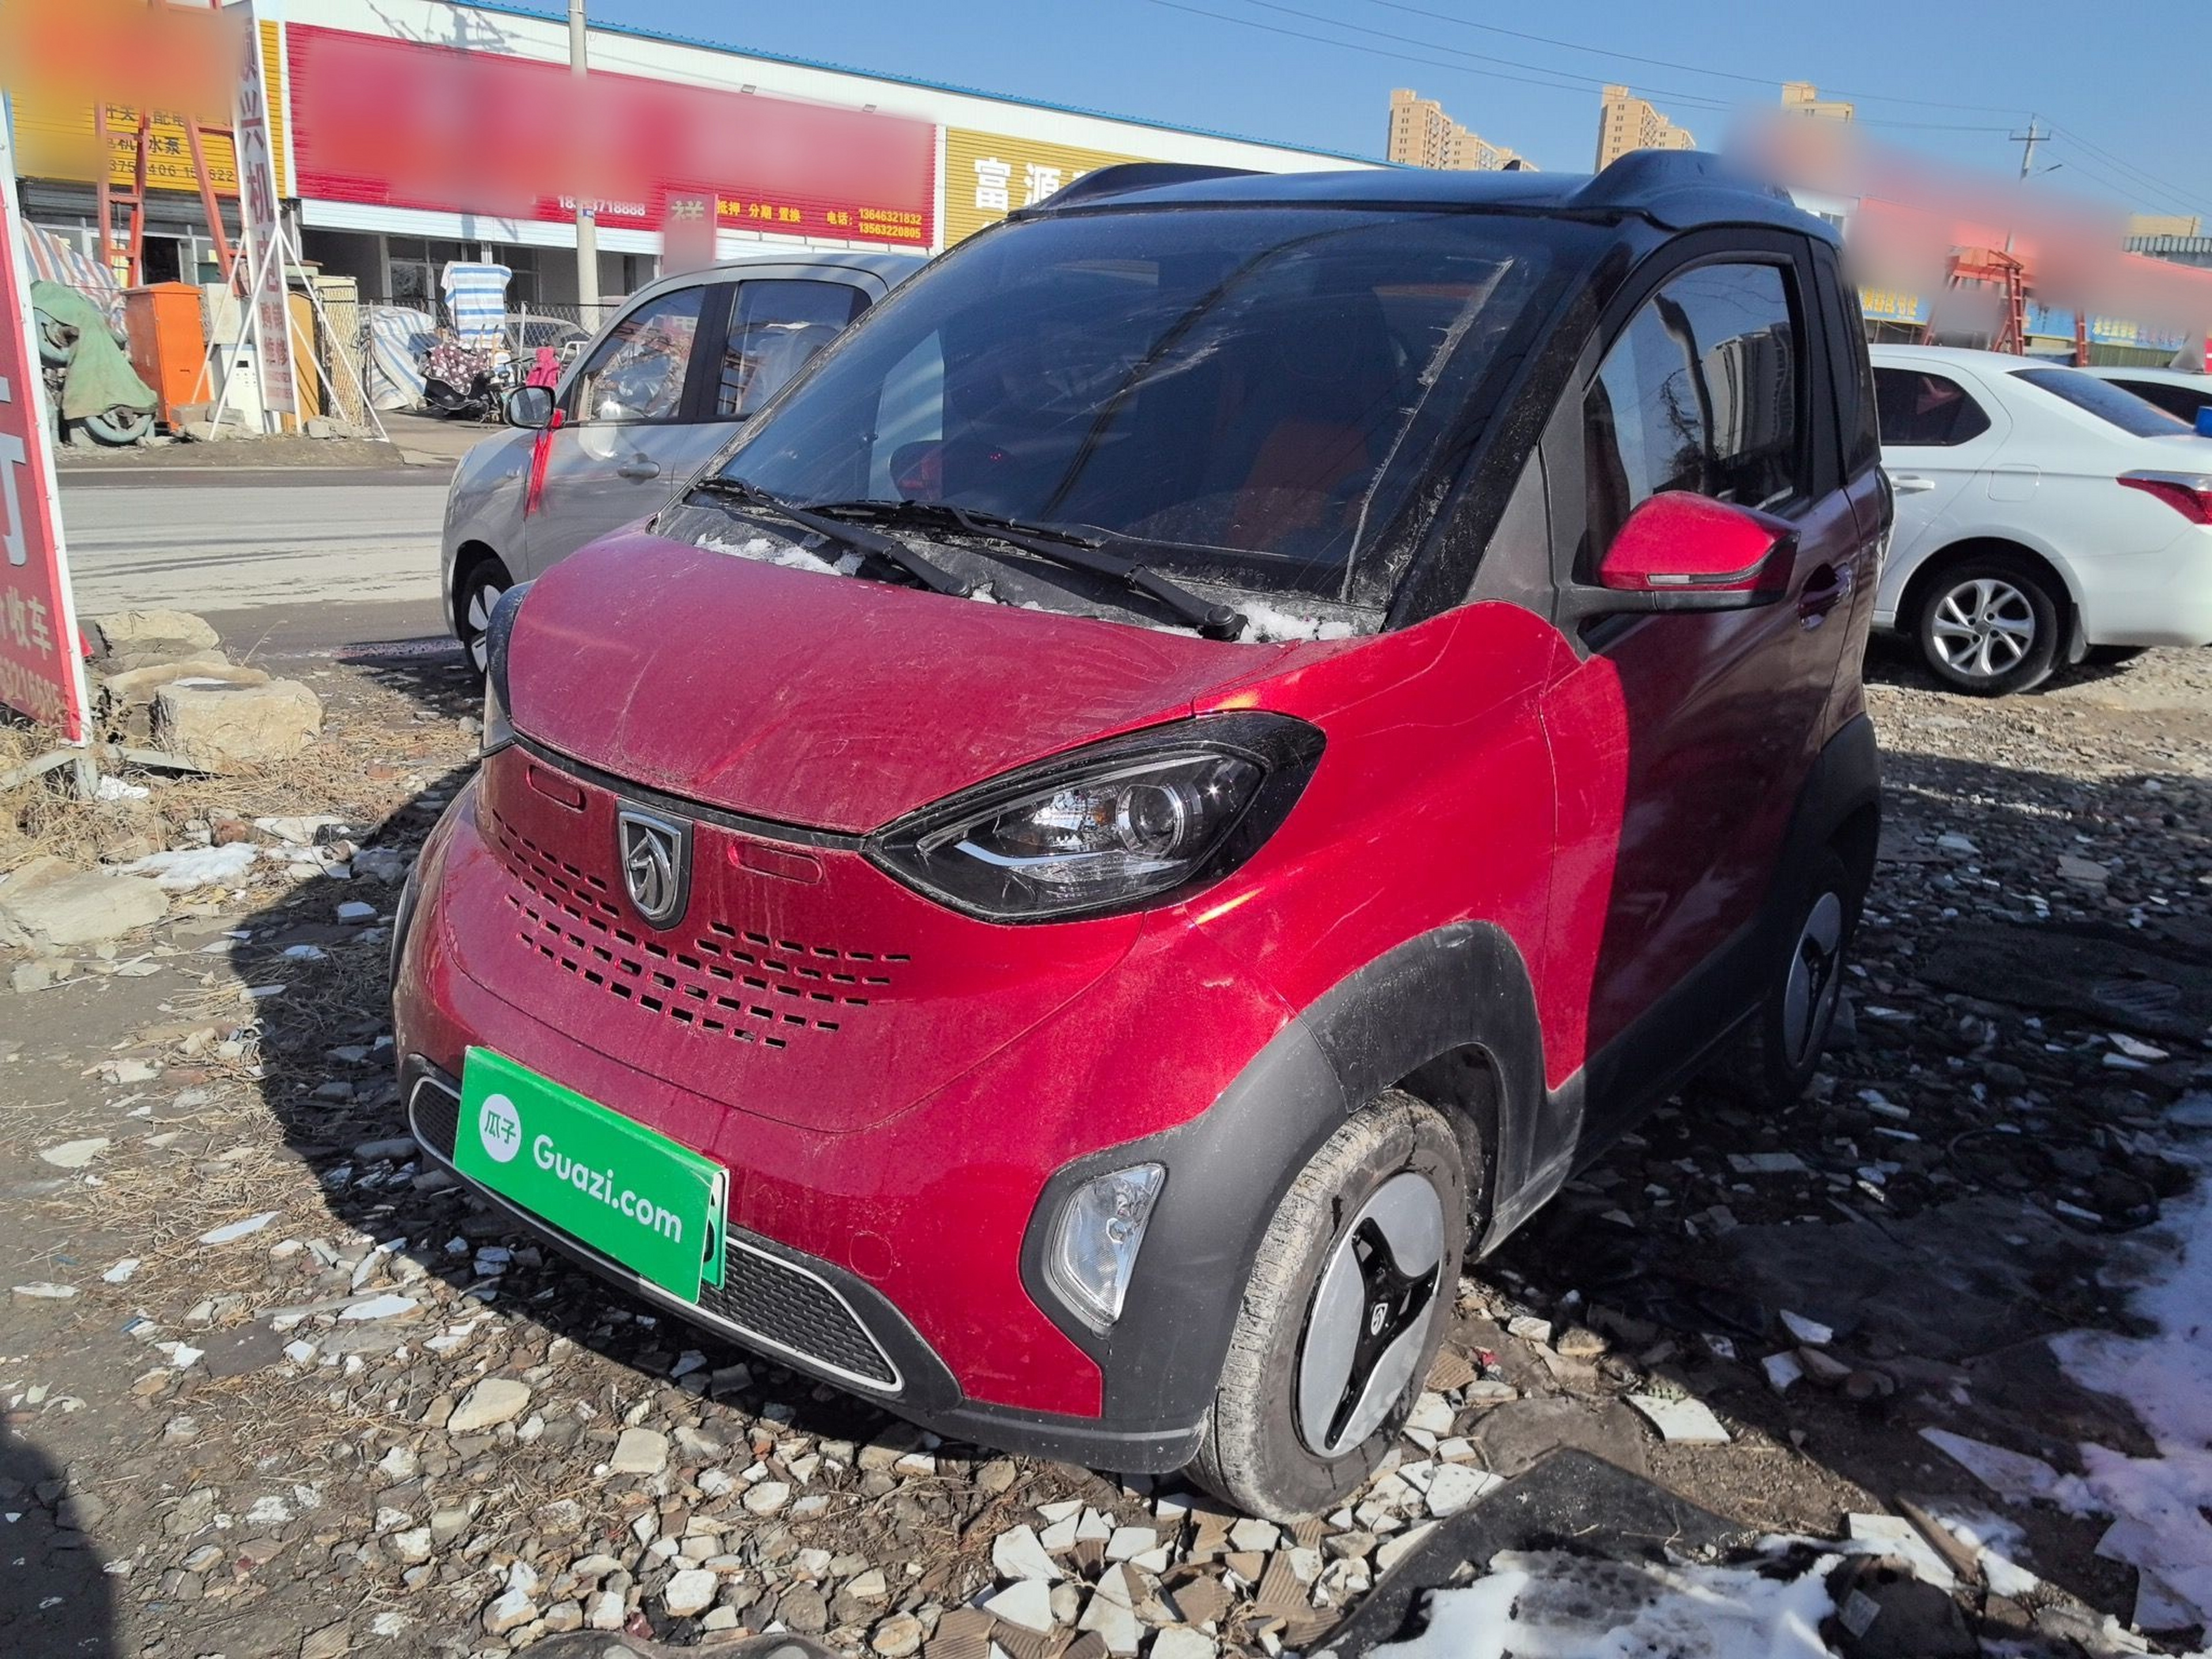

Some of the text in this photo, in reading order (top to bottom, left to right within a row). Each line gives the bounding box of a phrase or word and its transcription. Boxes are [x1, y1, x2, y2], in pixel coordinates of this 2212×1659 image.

[149, 134, 181, 154] 水泵
[749, 203, 772, 219] 分期
[778, 207, 801, 223] 置换
[859, 207, 922, 225] 13646321832
[859, 222, 922, 239] 13563220805
[484, 1109, 517, 1144] 瓜子
[533, 1134, 684, 1244] Guazi.com
